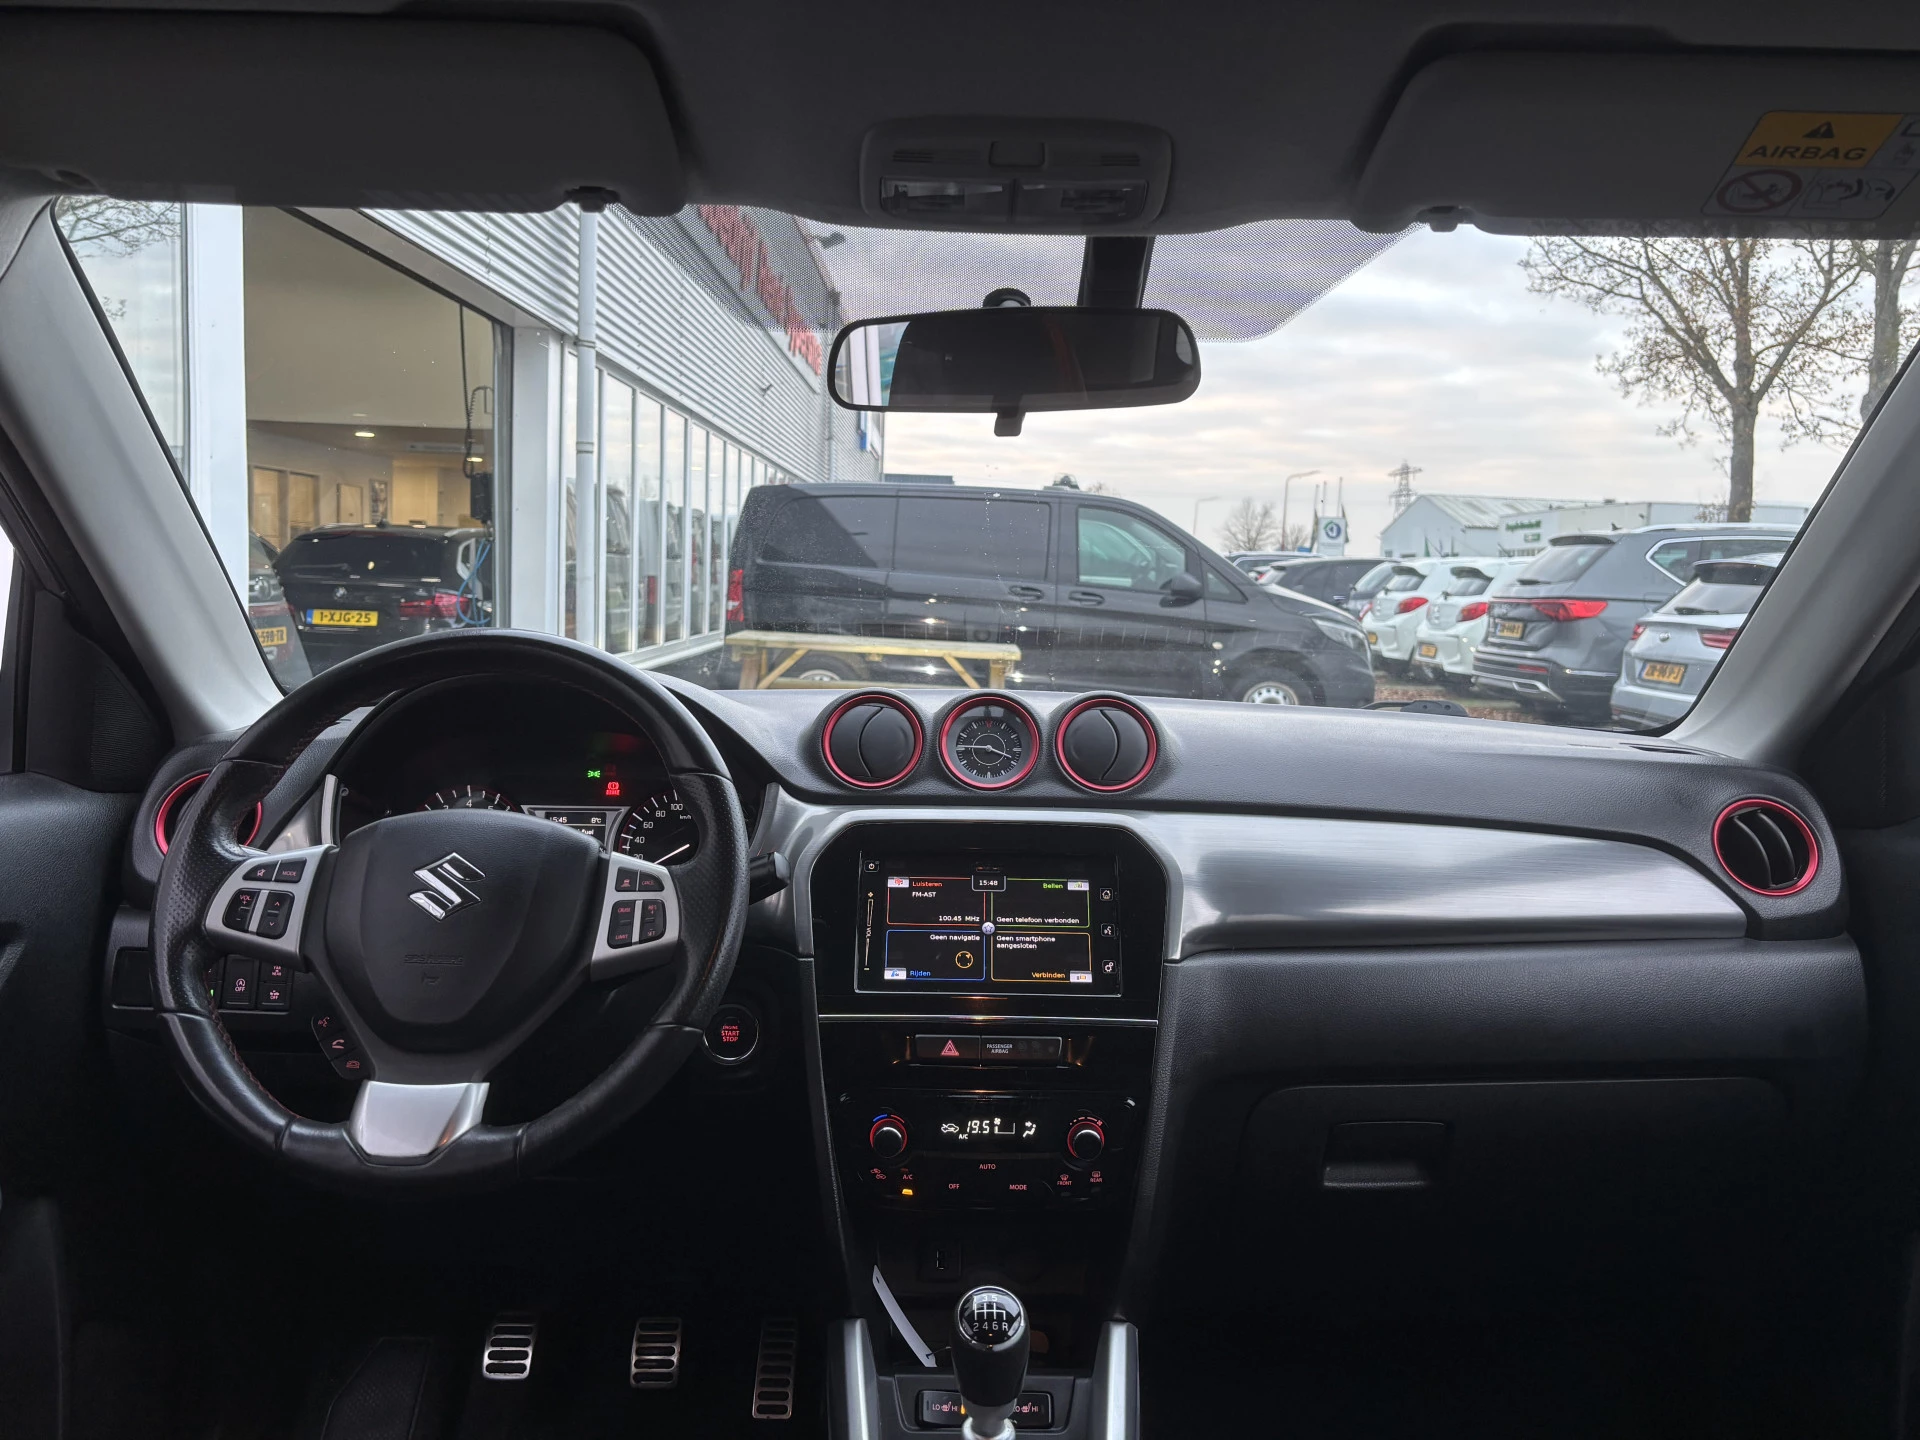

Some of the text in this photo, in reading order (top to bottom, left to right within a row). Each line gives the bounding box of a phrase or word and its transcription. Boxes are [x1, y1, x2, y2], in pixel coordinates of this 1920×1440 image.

[1747, 145, 1868, 161] AIRBAG
[319, 611, 371, 623] 1-XJG-25
[466, 800, 473, 808] 4
[655, 810, 666, 818] 80
[643, 821, 654, 829] 60
[634, 835, 645, 843] 40
[1015, 935, 1055, 943] smartphone
[909, 970, 931, 978] Rijden
[966, 1120, 990, 1134] 19.5
[973, 1321, 1009, 1332] 2 4 6 R
[932, 1403, 940, 1411] LO
